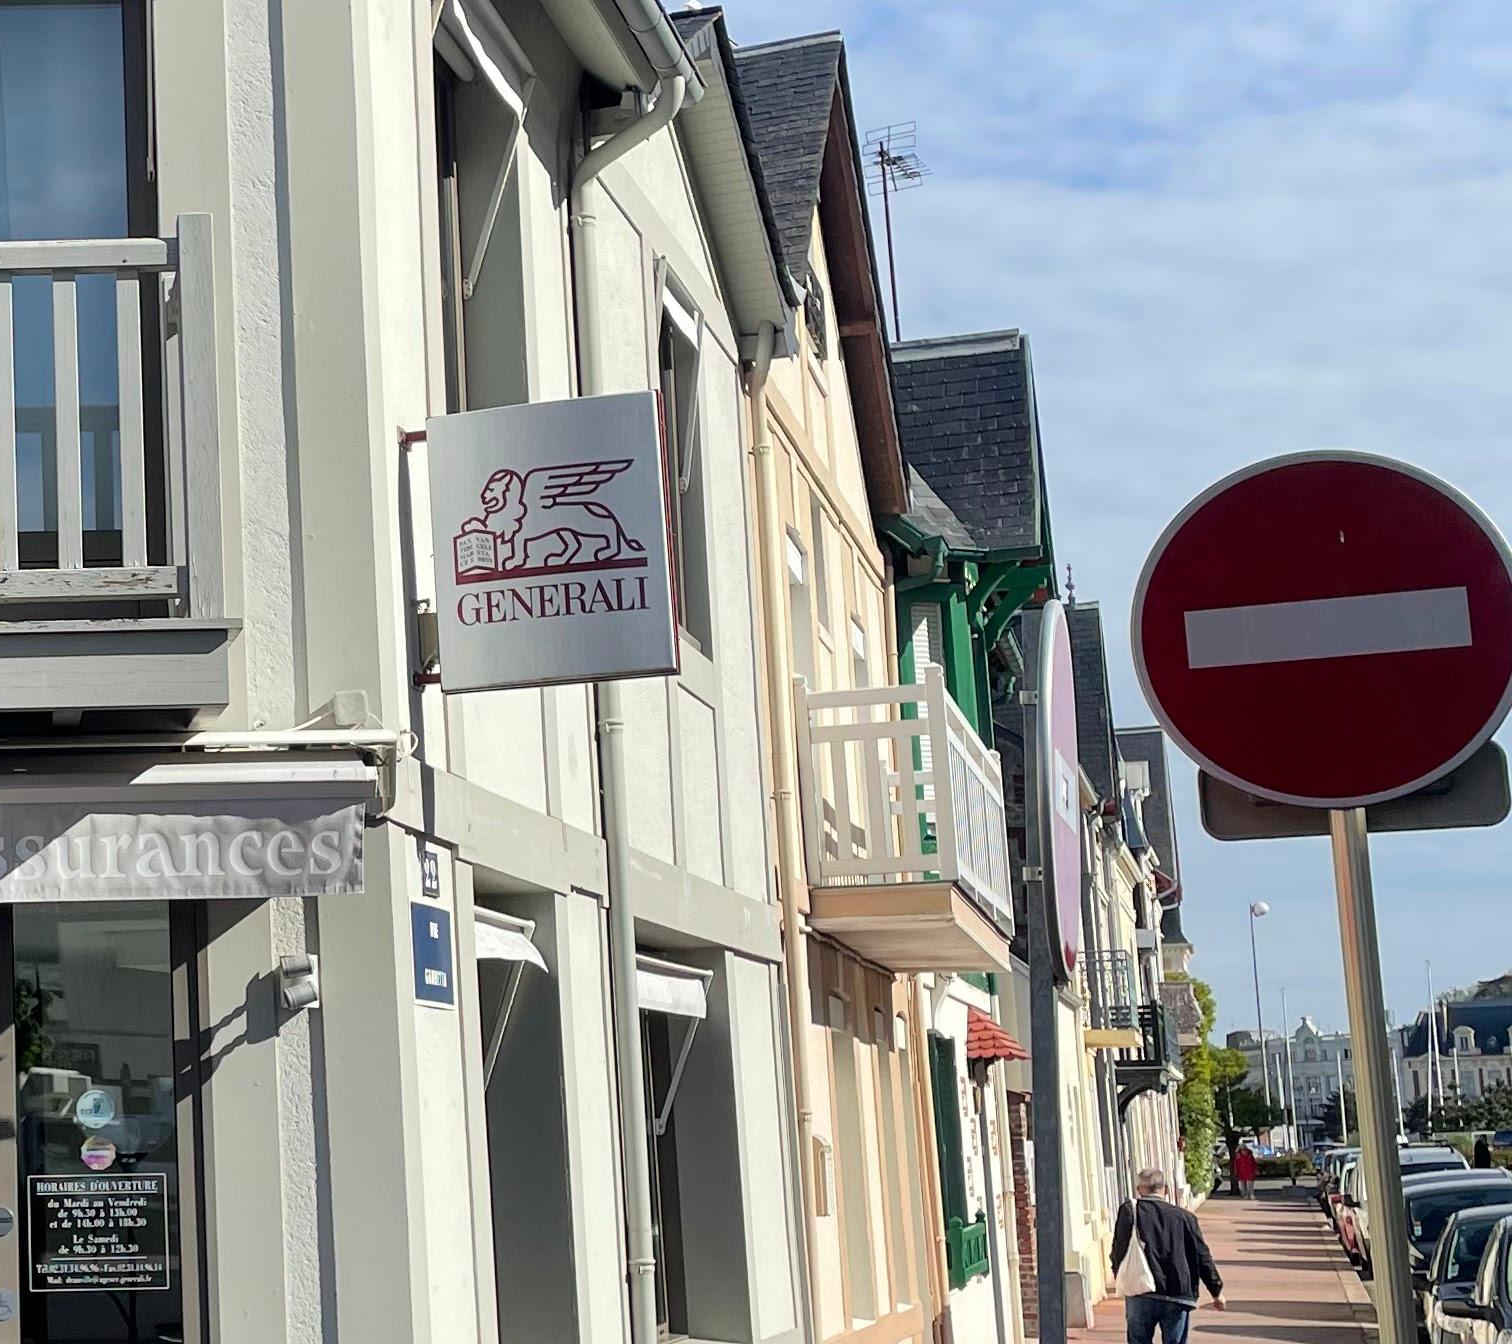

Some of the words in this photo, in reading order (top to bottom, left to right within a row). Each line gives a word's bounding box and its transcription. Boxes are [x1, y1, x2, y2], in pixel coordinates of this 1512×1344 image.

[456, 576, 650, 627] GENERALI
[36, 1181, 86, 1193] HORAIRES
[90, 1180, 158, 1192] D'OUVERTURE
[47, 1199, 59, 1208] du
[63, 1198, 89, 1208] Mardi
[107, 1197, 147, 1207] Vendredi
[57, 1209, 68, 1218] de
[61, 1219, 72, 1228] de
[72, 1234, 85, 1244] Le
[87, 1234, 119, 1243] Samedi
[57, 1245, 69, 1255] de
